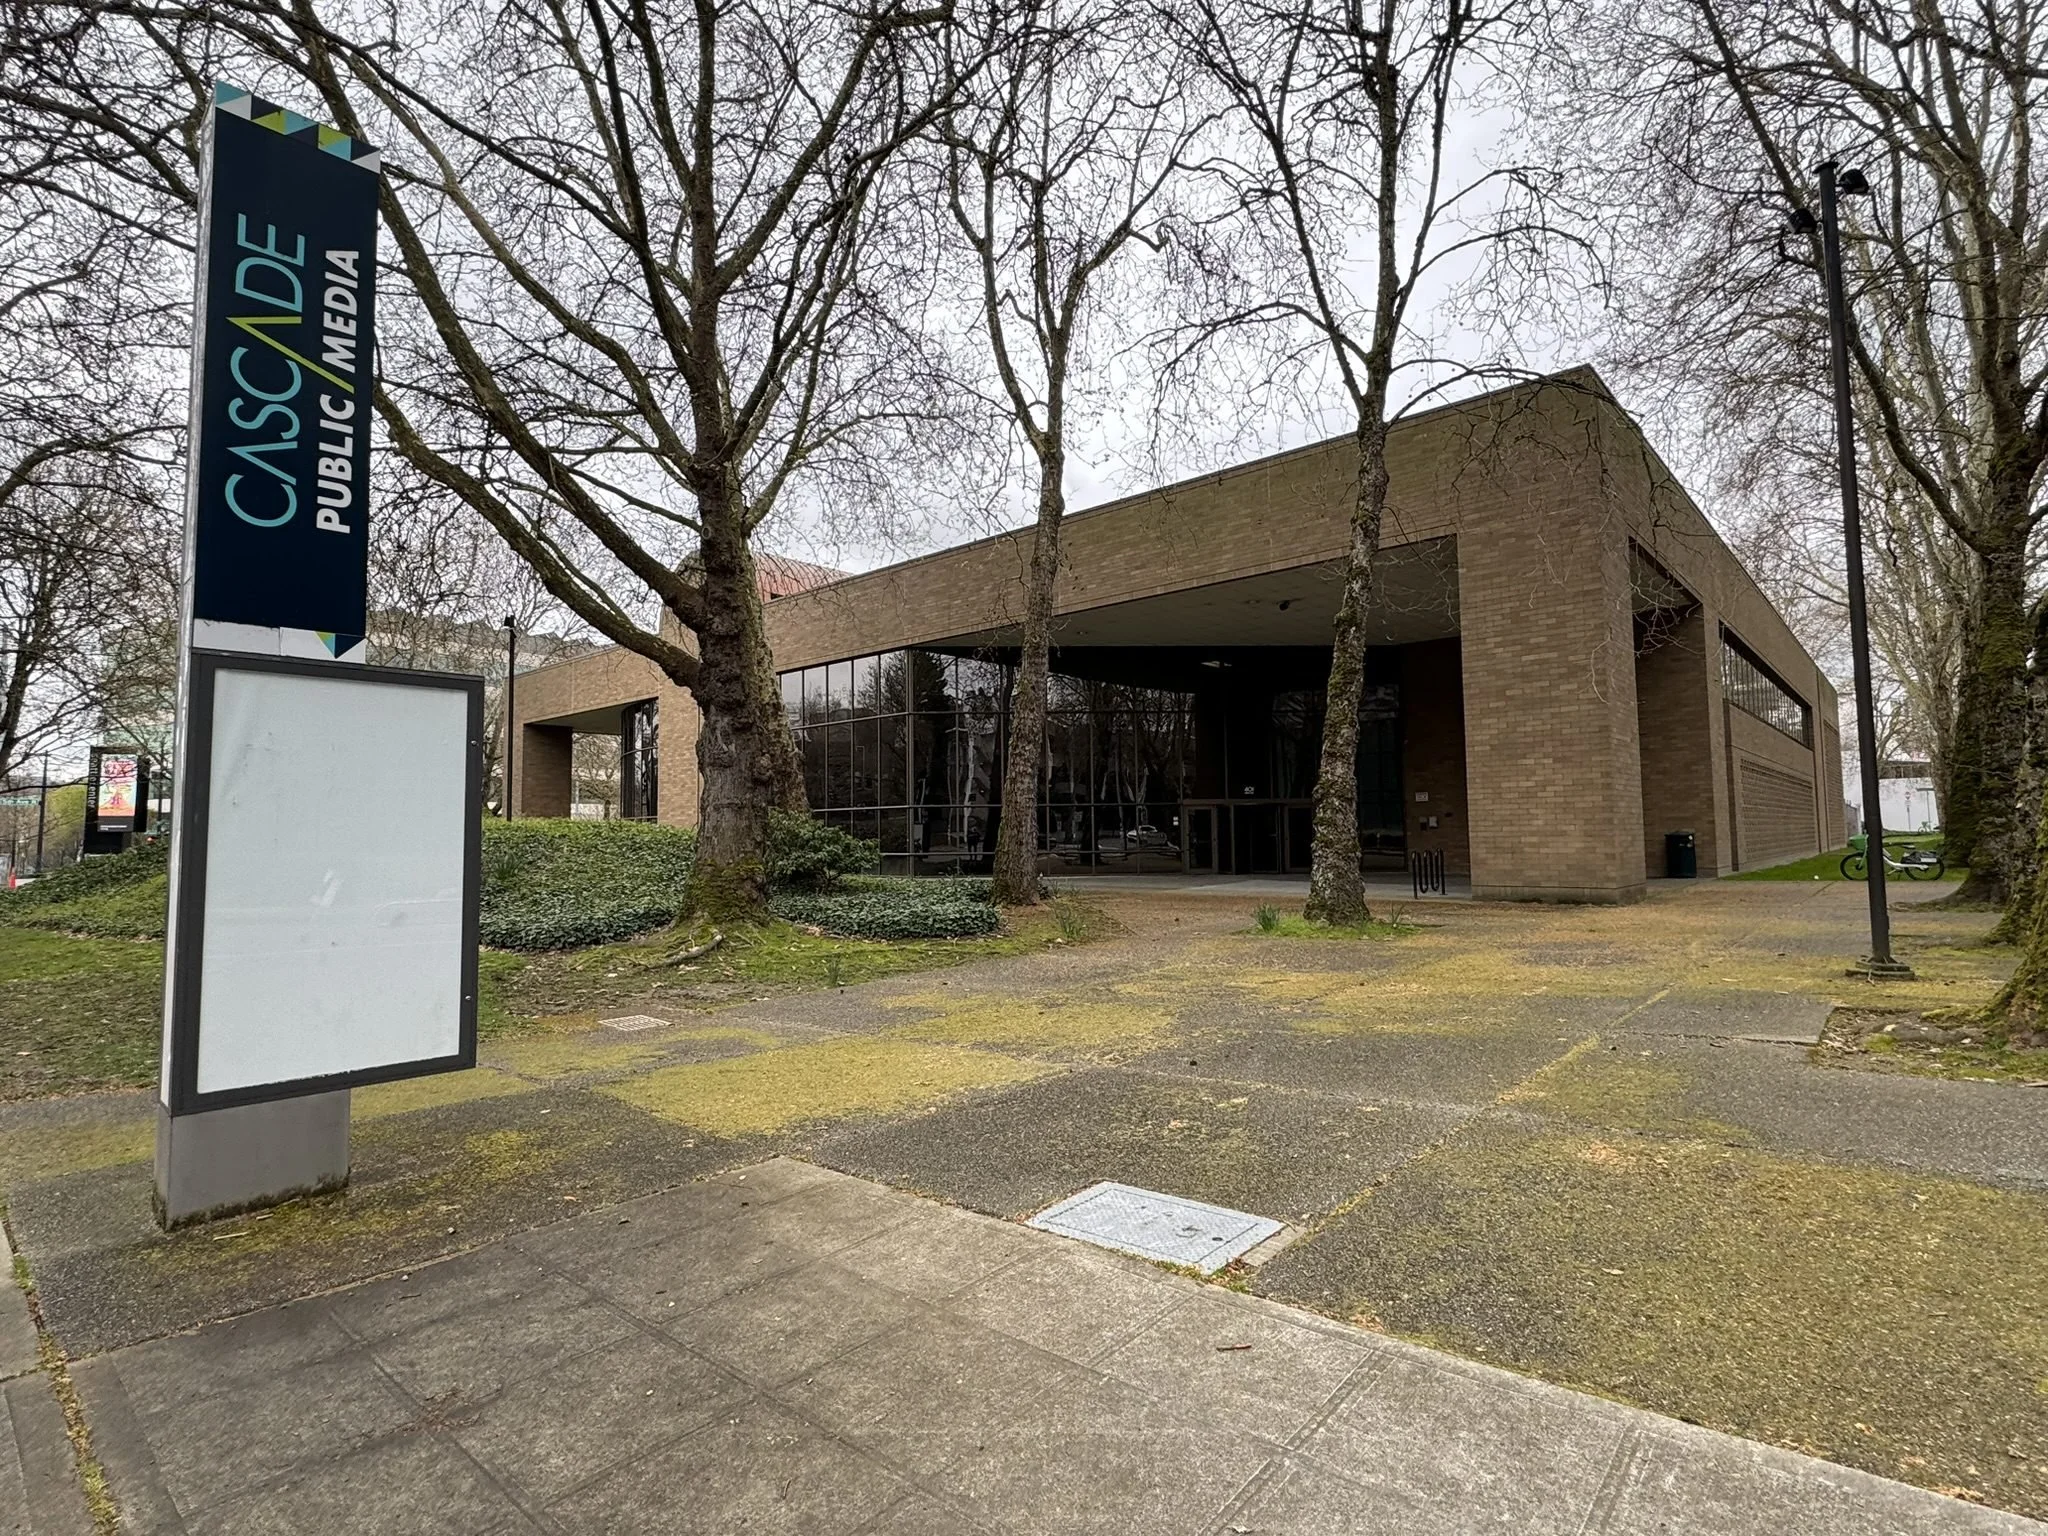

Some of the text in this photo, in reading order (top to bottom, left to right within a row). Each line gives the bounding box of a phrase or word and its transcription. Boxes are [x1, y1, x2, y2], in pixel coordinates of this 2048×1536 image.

[225, 213, 305, 528] CASCADE
[316, 250, 360, 534] PUBLIC MEDIA
